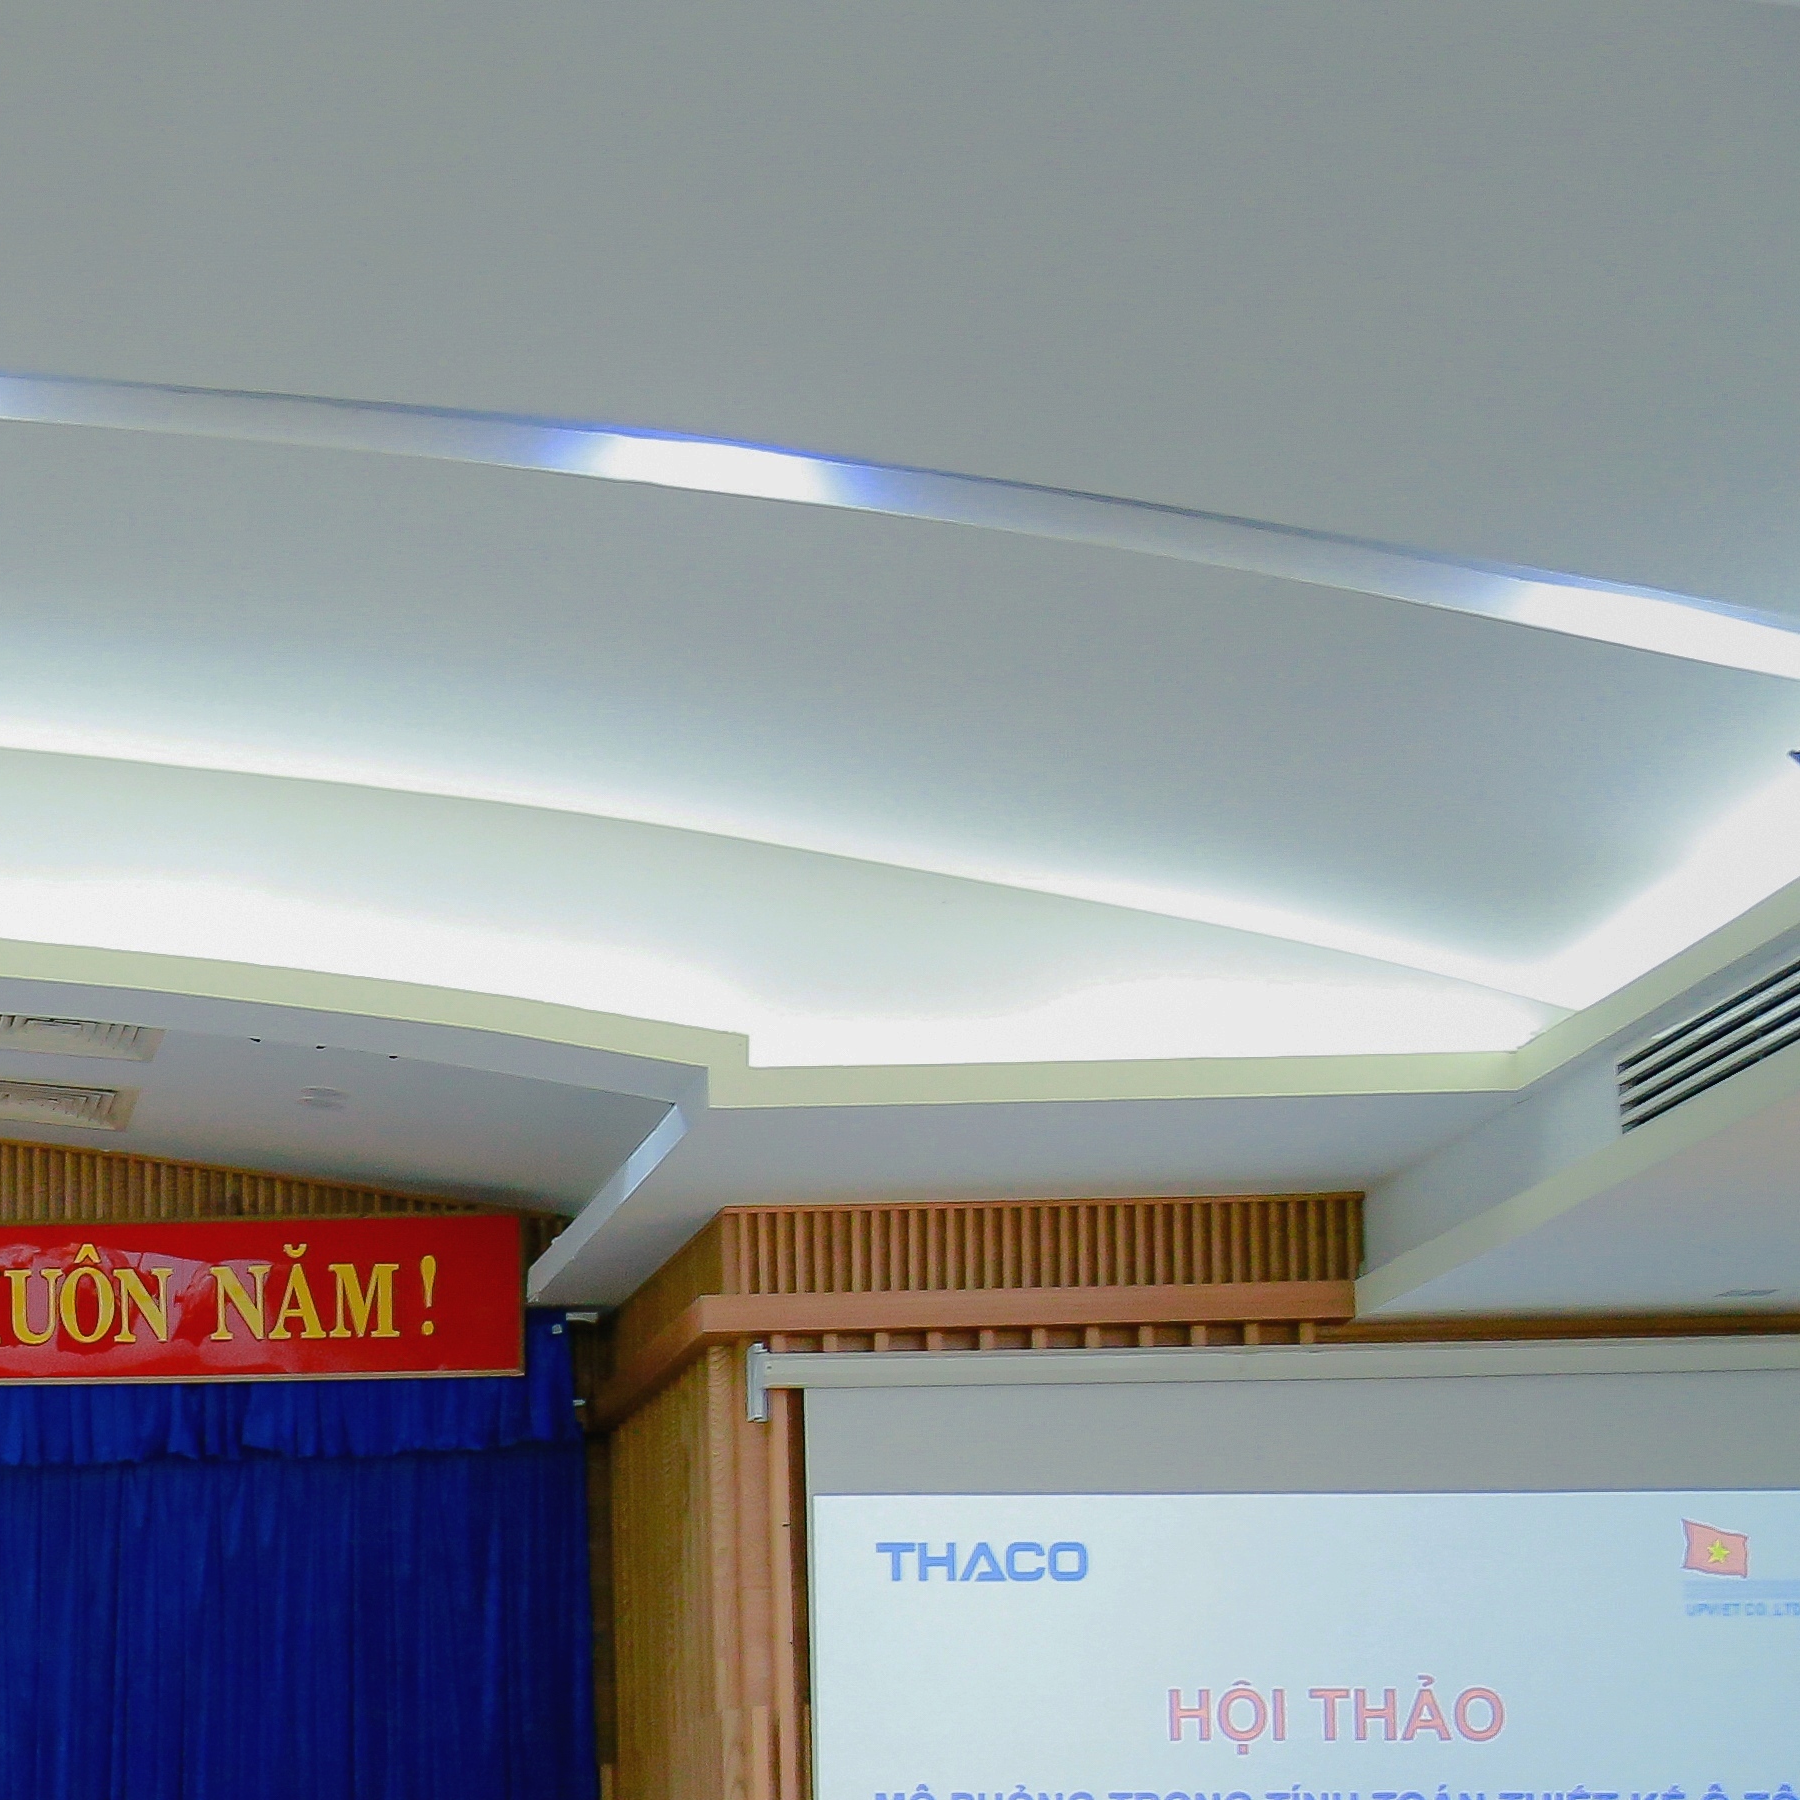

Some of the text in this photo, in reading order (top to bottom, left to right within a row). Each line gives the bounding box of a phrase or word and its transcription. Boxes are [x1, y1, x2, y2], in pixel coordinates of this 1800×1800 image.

[876, 1542, 1089, 1582] THACO
[1168, 1674, 1505, 1755] HỘI THẢO
